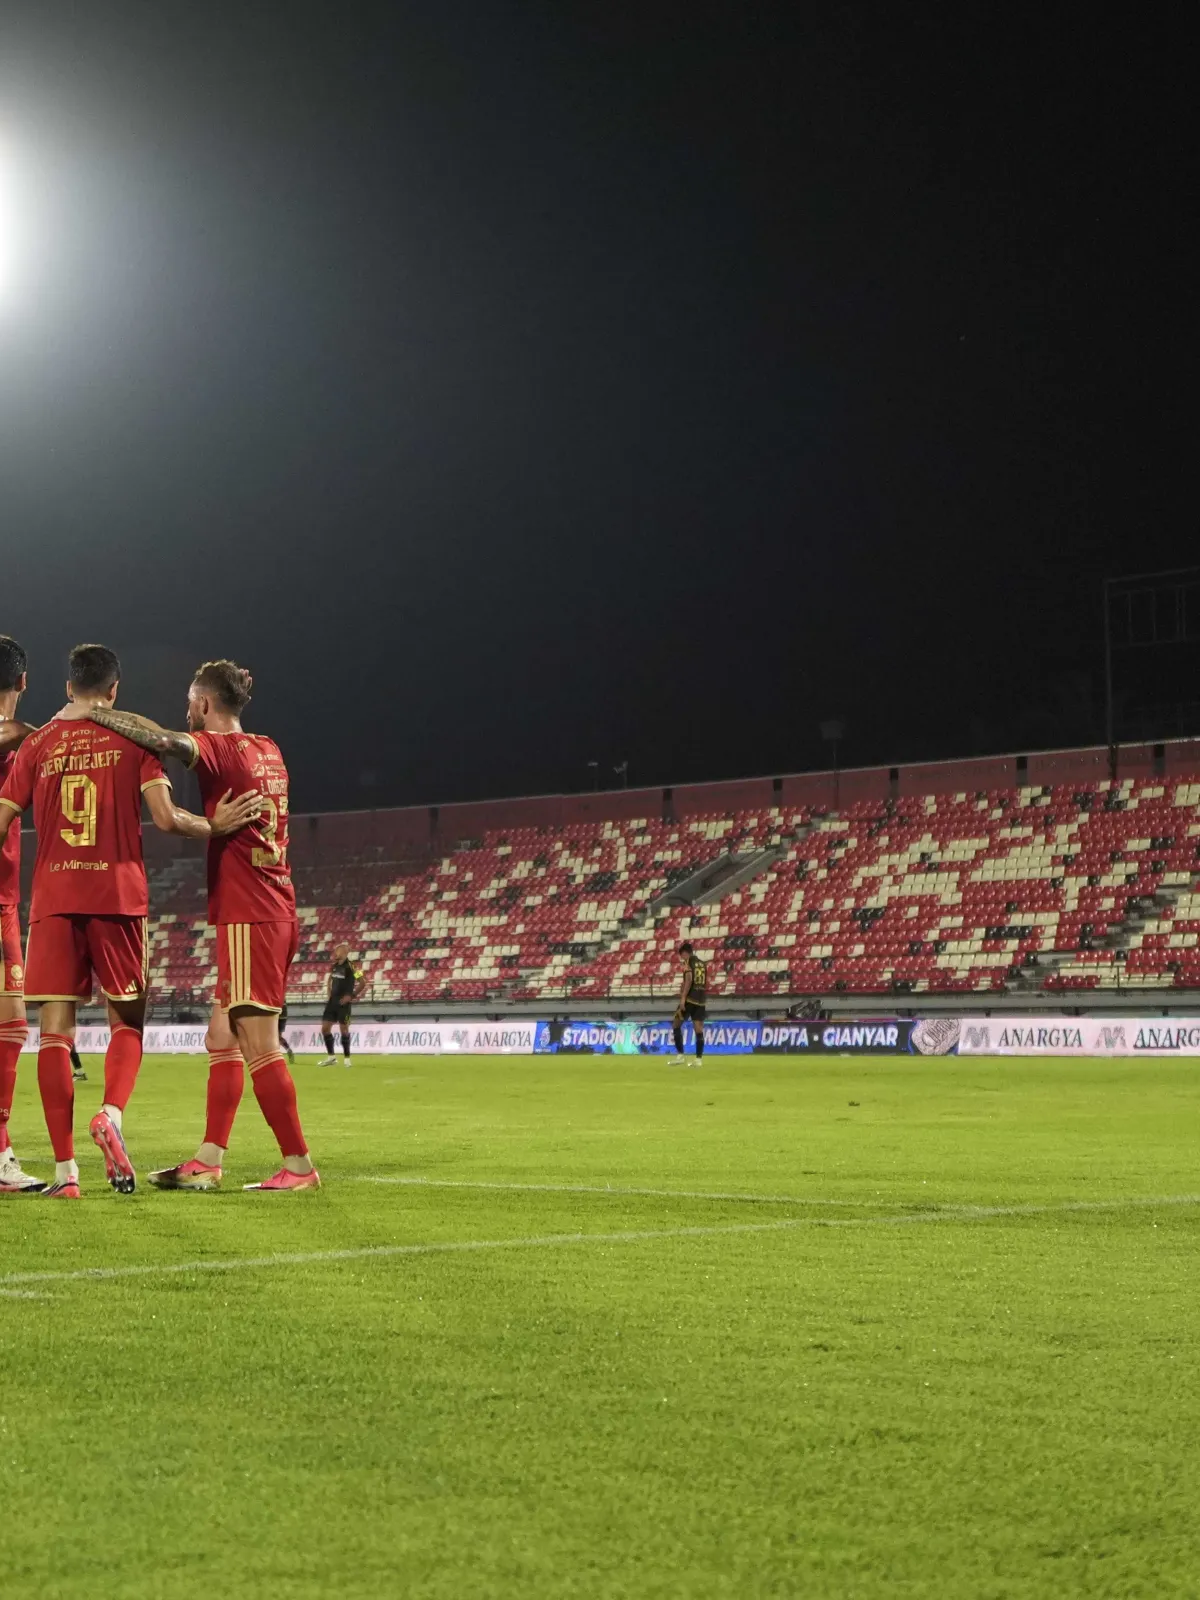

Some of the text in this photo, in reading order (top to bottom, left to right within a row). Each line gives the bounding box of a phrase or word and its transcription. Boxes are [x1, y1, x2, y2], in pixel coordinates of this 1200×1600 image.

[40, 750, 123, 778] JEREMEJEFF
[60, 774, 97, 847] 9
[50, 860, 109, 872] Le Minerale
[386, 1031, 442, 1047] ANARGYA
[473, 1030, 532, 1047] ANARGYA
[562, 1028, 625, 1046] STADION
[702, 1026, 757, 1047] WAYAN
[761, 1026, 809, 1047] DIPTA
[822, 1026, 899, 1047] GIANYAR
[999, 1027, 1083, 1048] ANARGYA
